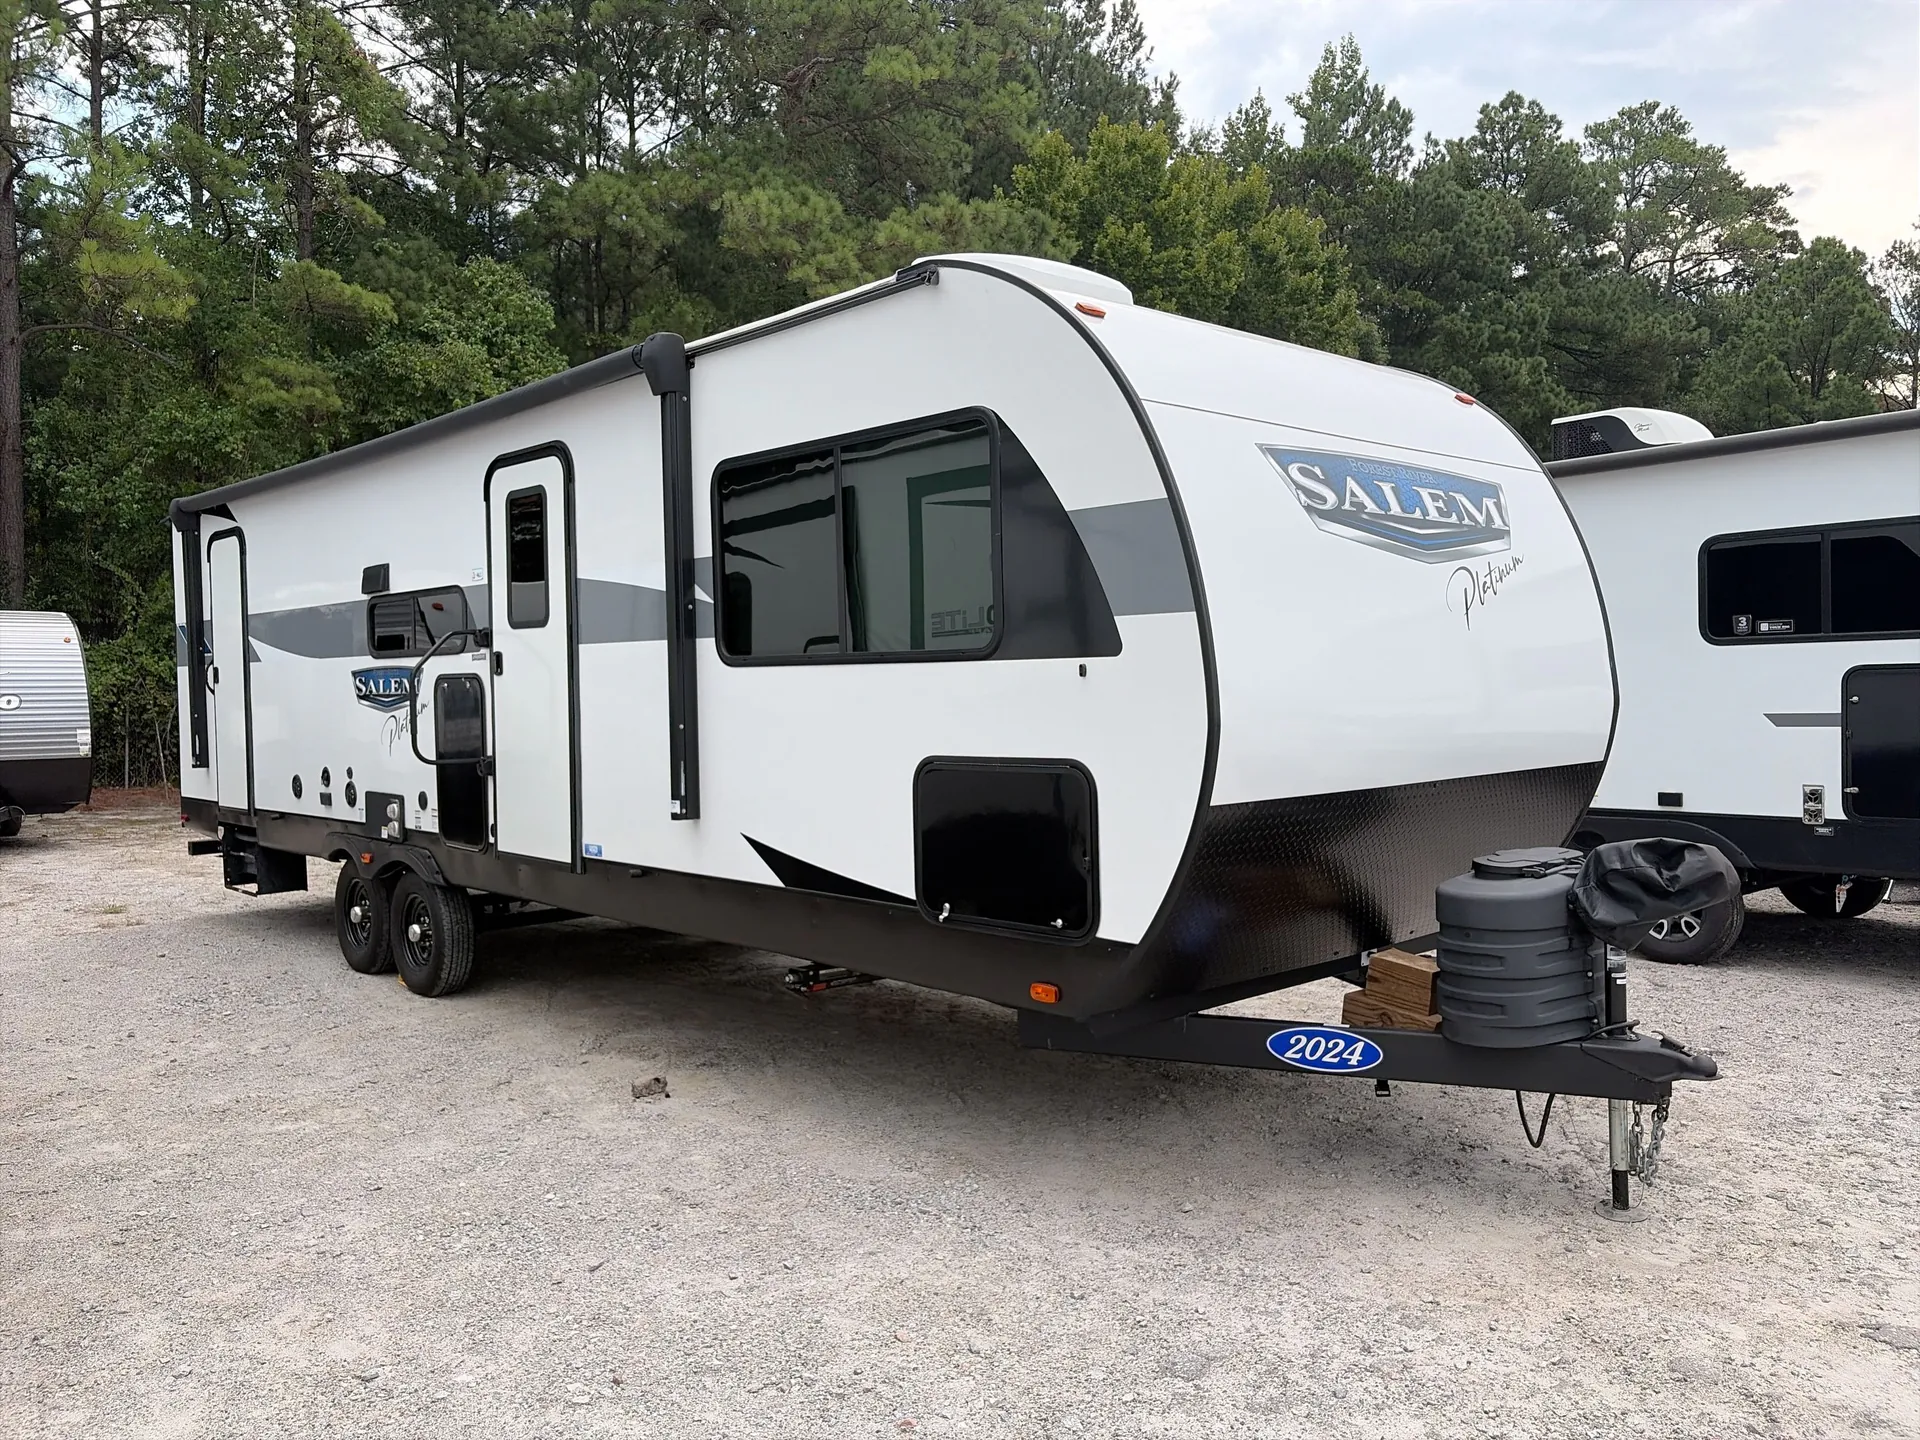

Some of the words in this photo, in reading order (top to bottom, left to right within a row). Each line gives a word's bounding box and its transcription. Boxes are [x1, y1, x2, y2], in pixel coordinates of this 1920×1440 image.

[1287, 462, 1510, 531] SALEM
[1446, 554, 1525, 631] Platinum
[1738, 616, 1747, 627] 3
[381, 700, 429, 757] Platum
[1284, 1034, 1365, 1066] 2024
